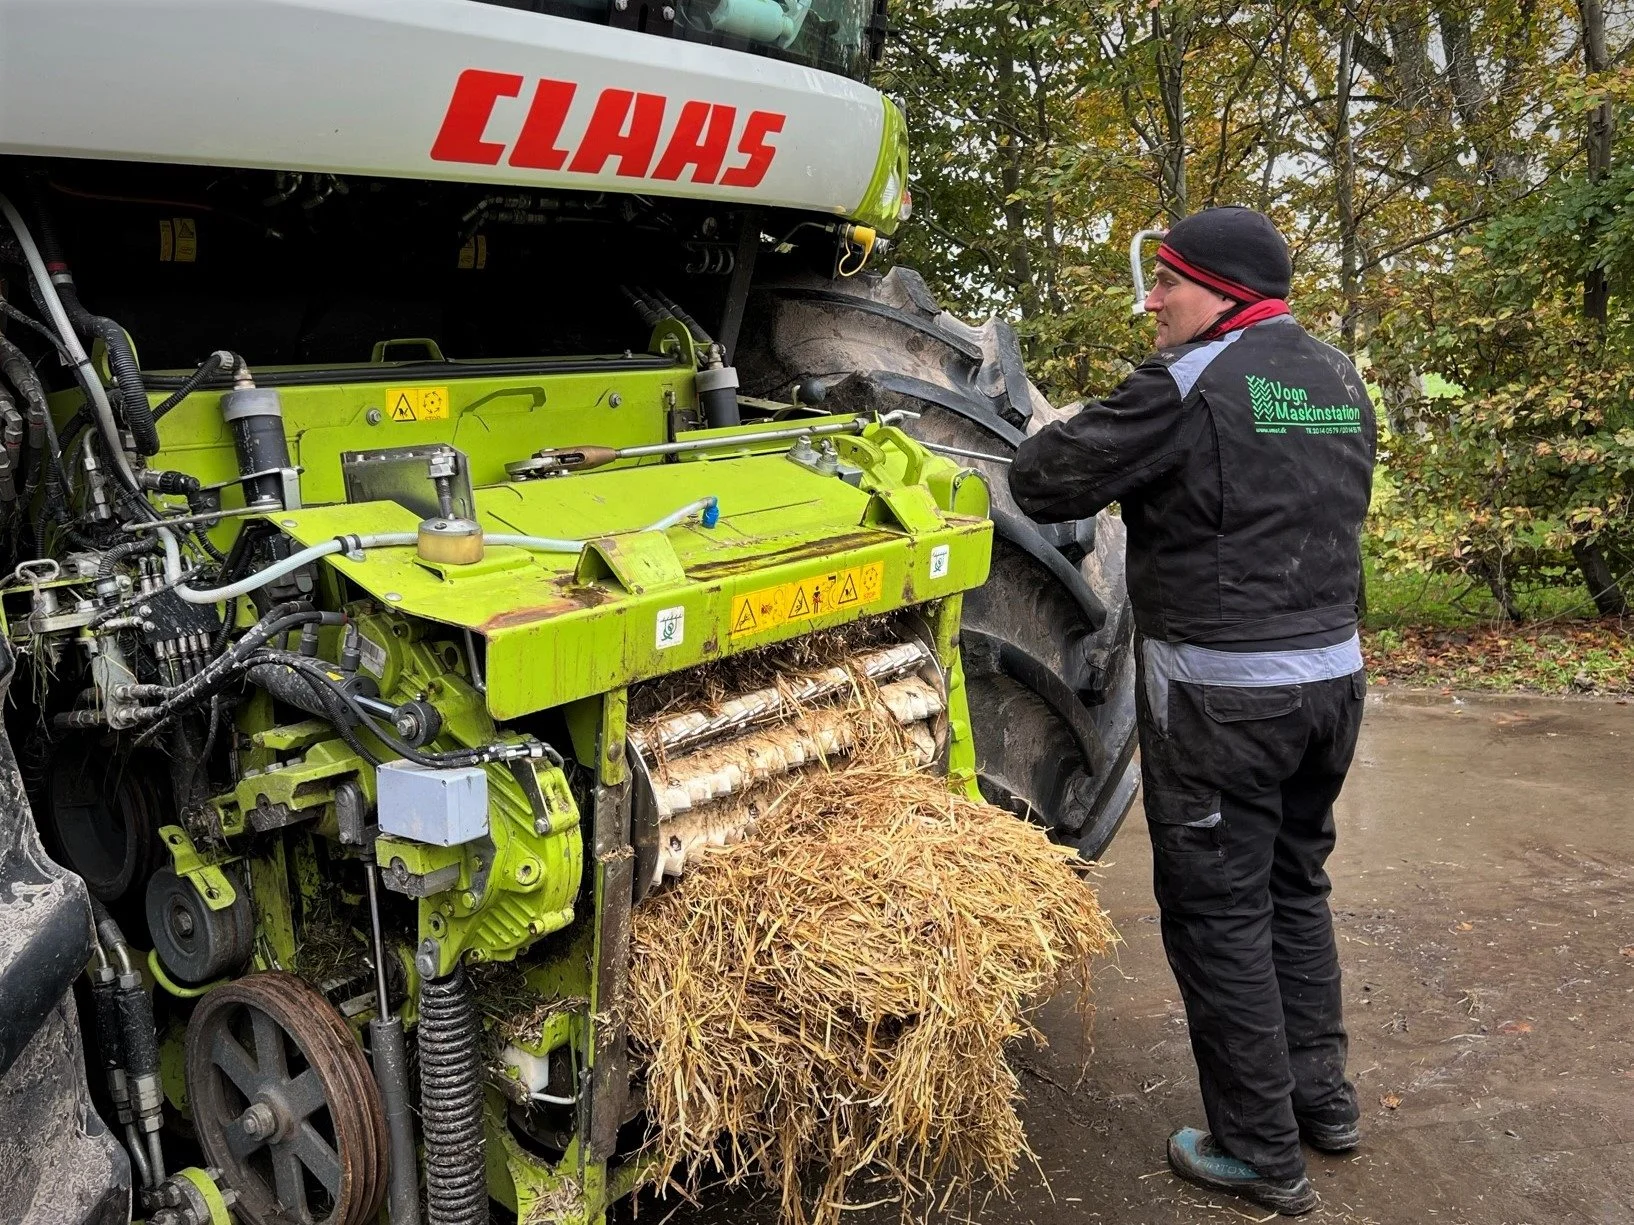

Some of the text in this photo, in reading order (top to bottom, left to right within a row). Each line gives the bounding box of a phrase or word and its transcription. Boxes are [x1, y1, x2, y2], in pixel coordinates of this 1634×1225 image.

[430, 68, 786, 188] CLAAS
[1270, 381, 1308, 406] Vogn
[1275, 401, 1360, 422] Maskinstation
[1195, 1159, 1247, 1176] AIRTOX
